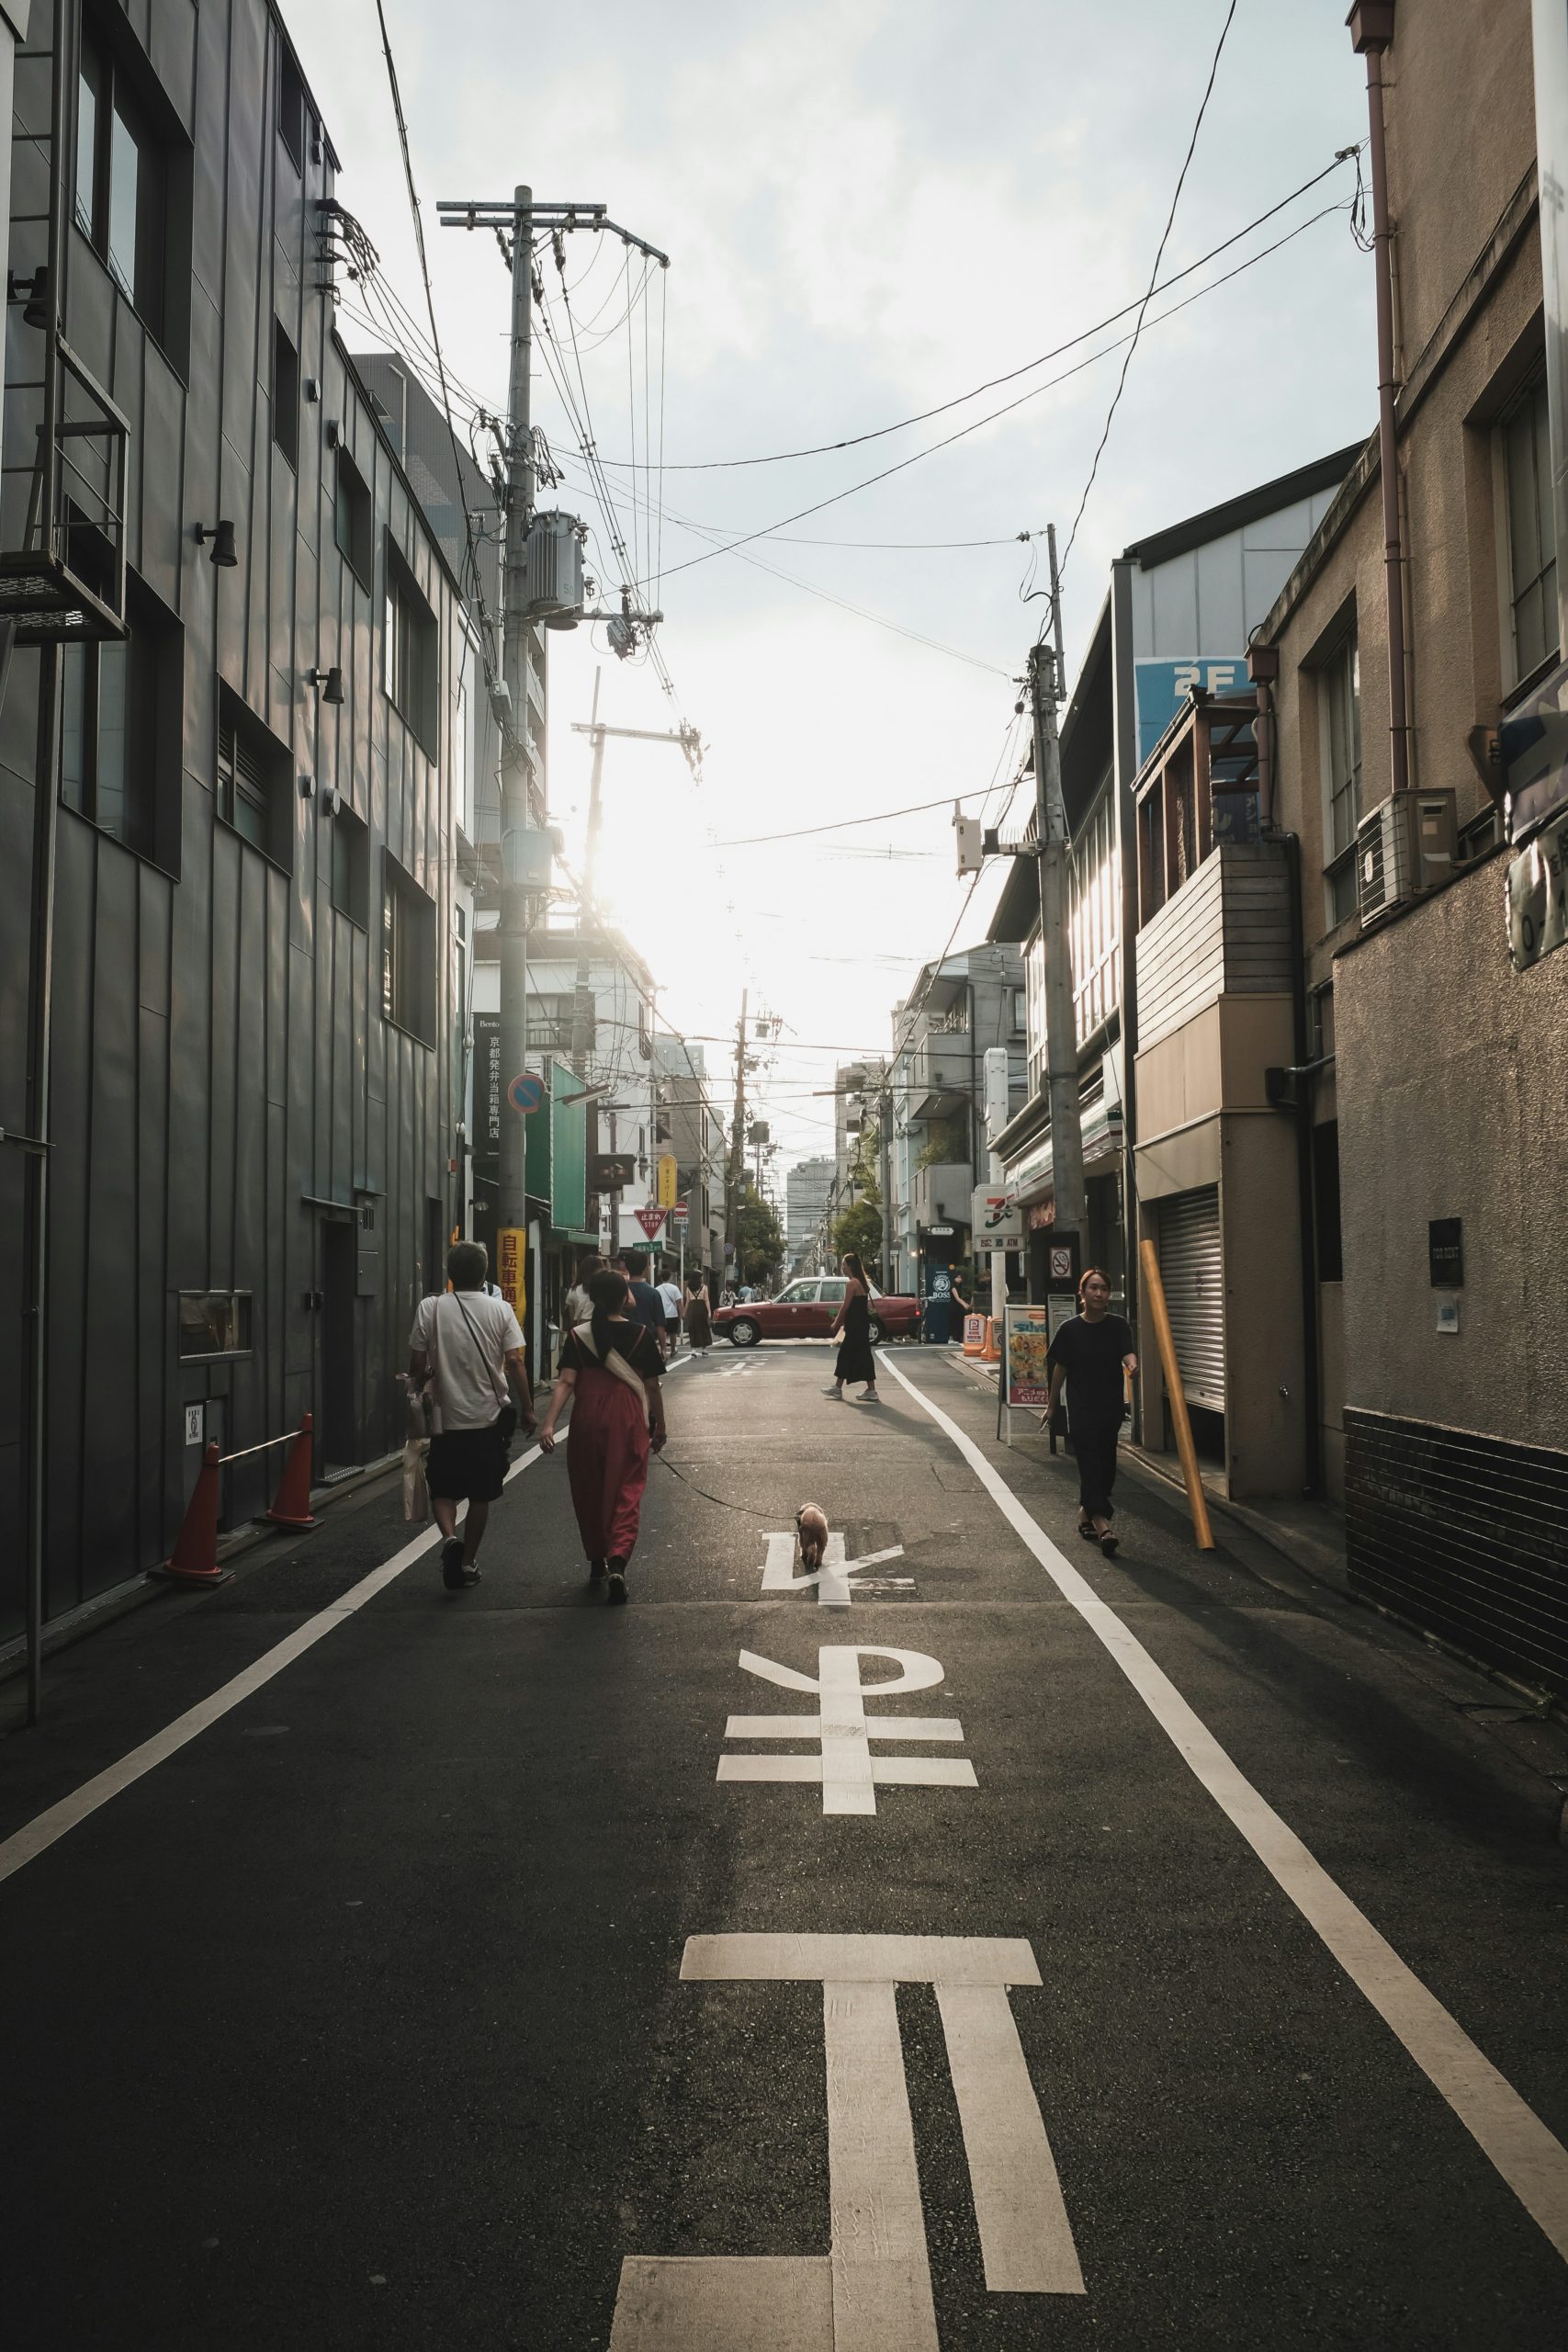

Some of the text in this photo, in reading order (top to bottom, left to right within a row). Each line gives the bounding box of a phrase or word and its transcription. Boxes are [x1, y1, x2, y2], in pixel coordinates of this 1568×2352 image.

[1173, 665, 1235, 696] 2F
[489, 1036, 501, 1138] 京都発弁当箱専門店
[641, 1212, 661, 1221] 止まれ
[1007, 1238, 1018, 1247] ATM
[932, 1291, 951, 1299] BOSS
